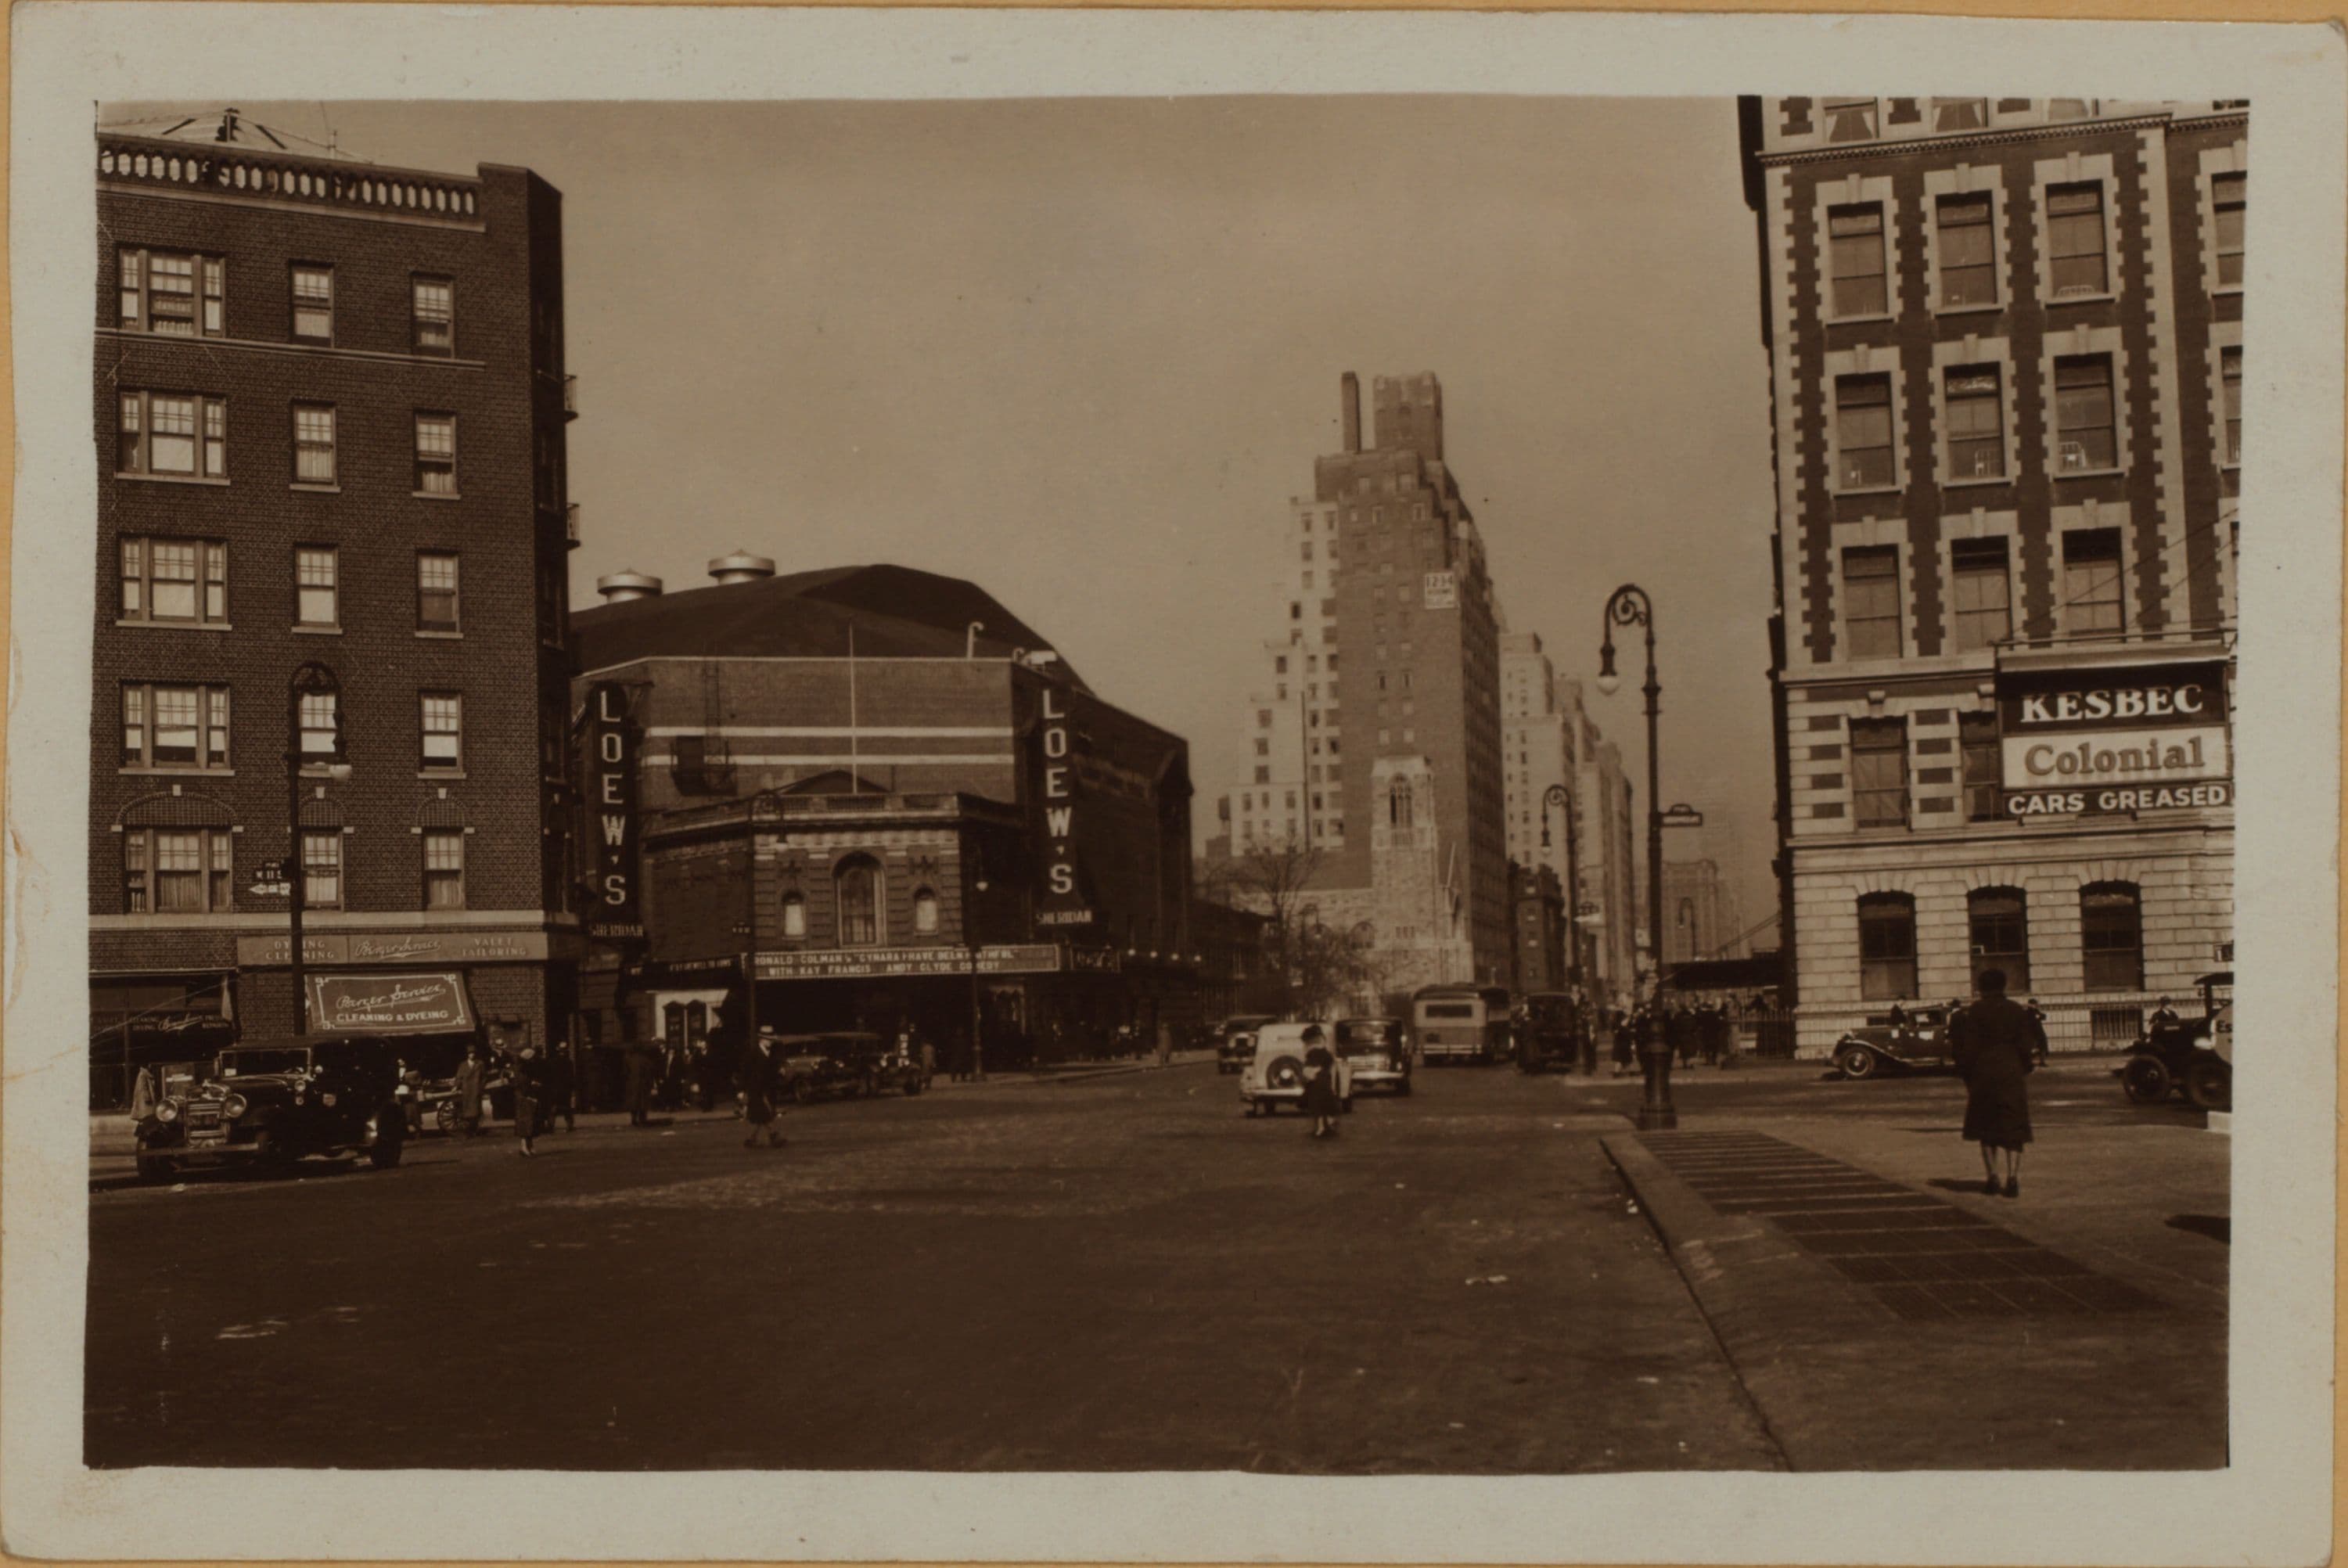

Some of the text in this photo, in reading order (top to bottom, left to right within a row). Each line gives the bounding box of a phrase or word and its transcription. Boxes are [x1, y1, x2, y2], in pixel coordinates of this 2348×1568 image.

[2020, 684, 2202, 722] KESBEC
[2025, 735, 2205, 776] Colonial
[600, 690, 626, 905] LOEW'S
[1042, 690, 1072, 894] LOEW'S
[2008, 785, 2227, 815] CARS GREASED
[1035, 910, 1091, 925] SHERIDAN
[588, 924, 643, 937] SHERIDAN
[274, 940, 325, 950] DYING
[474, 937, 512, 946] VALET
[265, 951, 335, 960] CLENING
[462, 946, 527, 957] TAILORING
[753, 955, 793, 965] RONALD
[768, 967, 793, 976] WITH
[800, 966, 821, 975] KAY
[827, 964, 872, 974] FRANCIS
[886, 963, 912, 972] ANDY
[919, 962, 952, 971] CLYDE
[336, 1013, 394, 1022] CLEANING
[405, 1010, 449, 1020] DYEING
